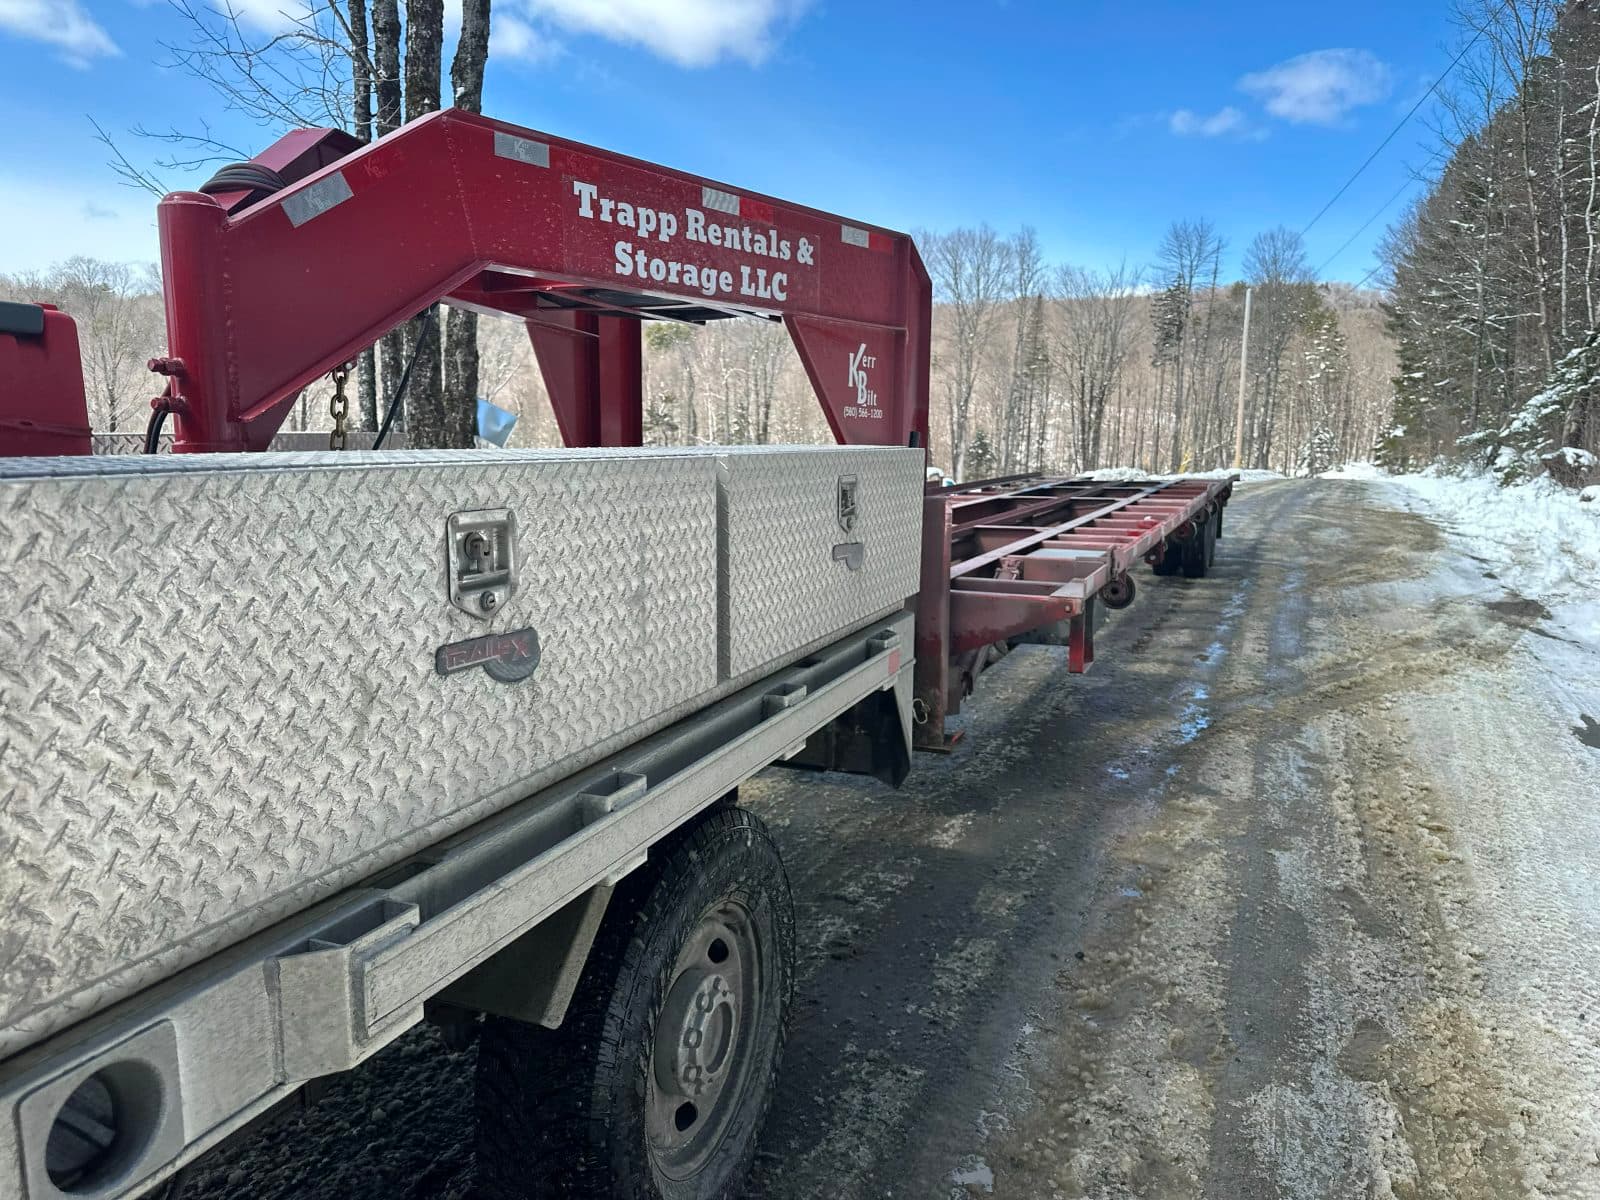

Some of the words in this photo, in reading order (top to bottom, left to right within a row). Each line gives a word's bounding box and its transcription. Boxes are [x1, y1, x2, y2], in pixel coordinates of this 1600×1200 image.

[573, 181, 678, 243] Trapp
[685, 208, 791, 261] Rentals
[797, 236, 815, 266] &
[614, 240, 733, 296] Storage
[740, 265, 788, 301] LLC
[848, 343, 876, 387] Kerr
[857, 370, 877, 405] Bilt
